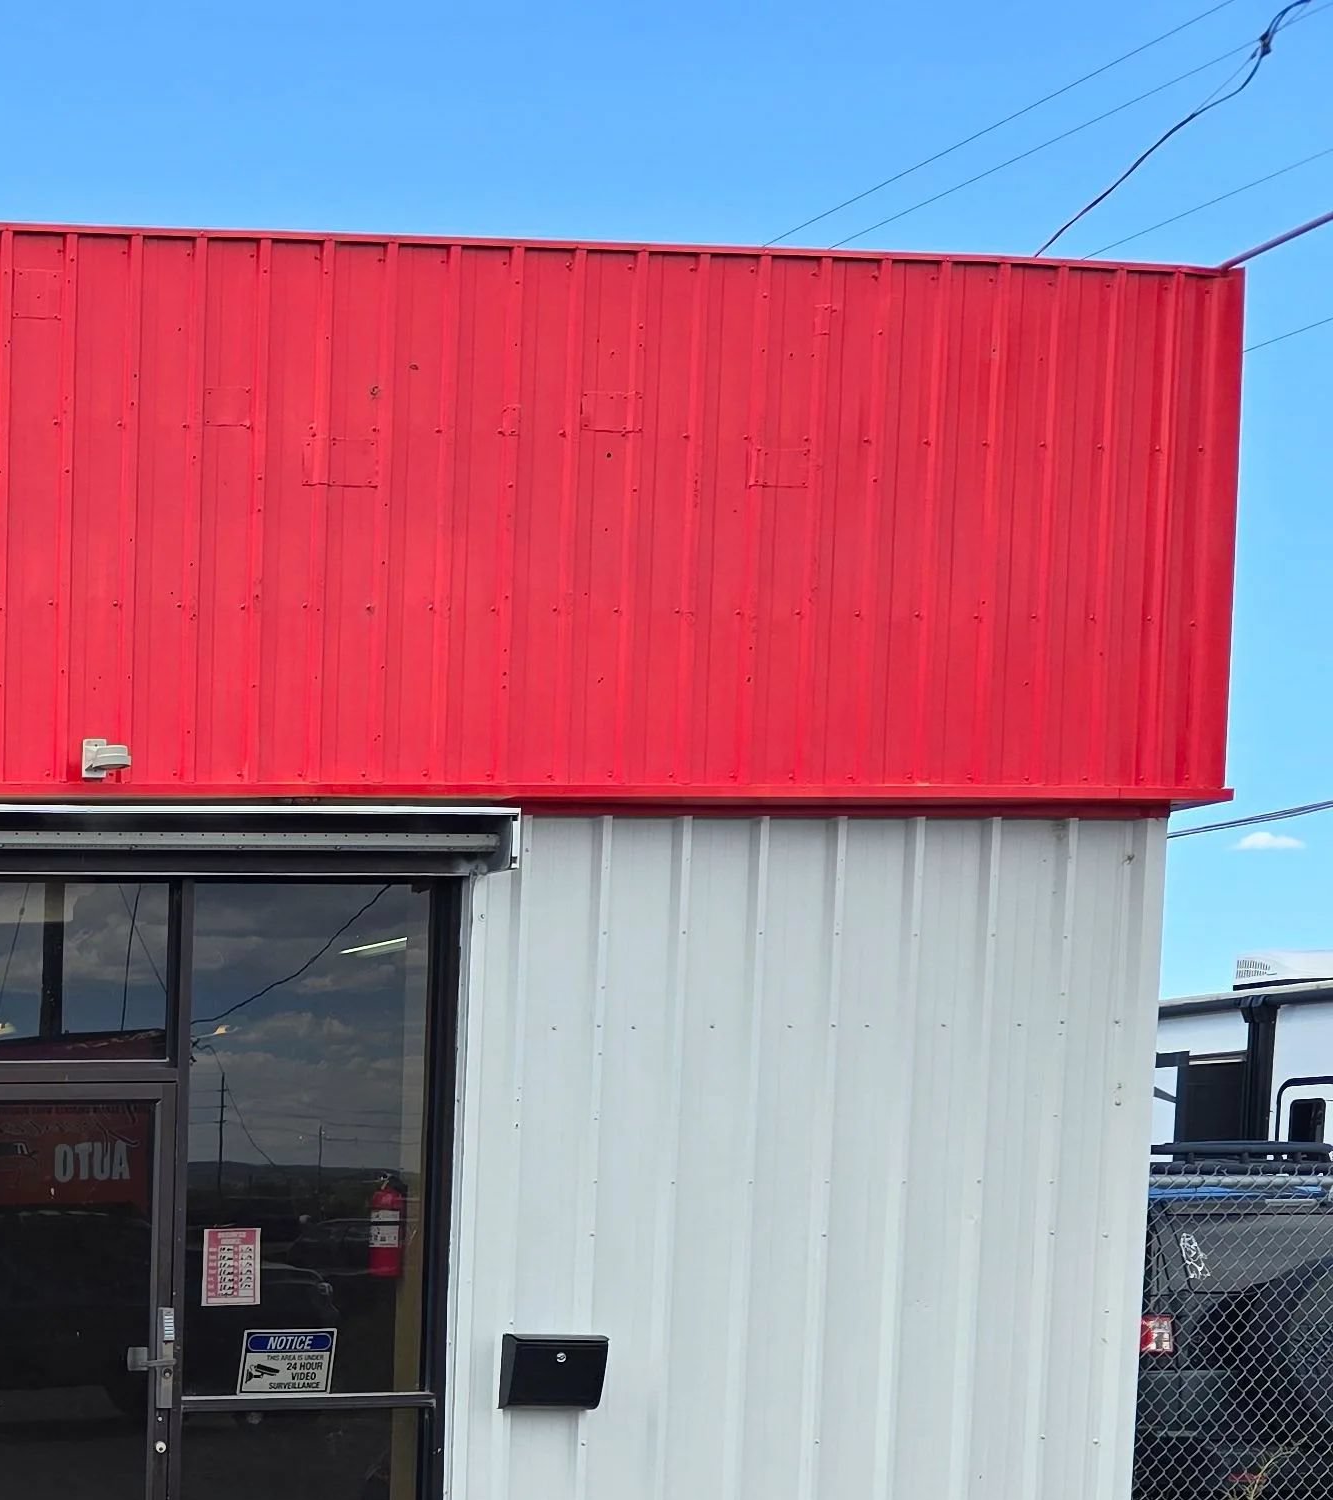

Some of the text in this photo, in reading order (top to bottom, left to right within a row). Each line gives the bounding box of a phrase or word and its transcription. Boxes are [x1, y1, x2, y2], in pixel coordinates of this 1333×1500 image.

[267, 1335, 314, 1350] NOTICE
[286, 1361, 323, 1371] 24 HOUR
[291, 1371, 317, 1381] VIDEO
[268, 1381, 320, 1390] SURVEILLANCE
